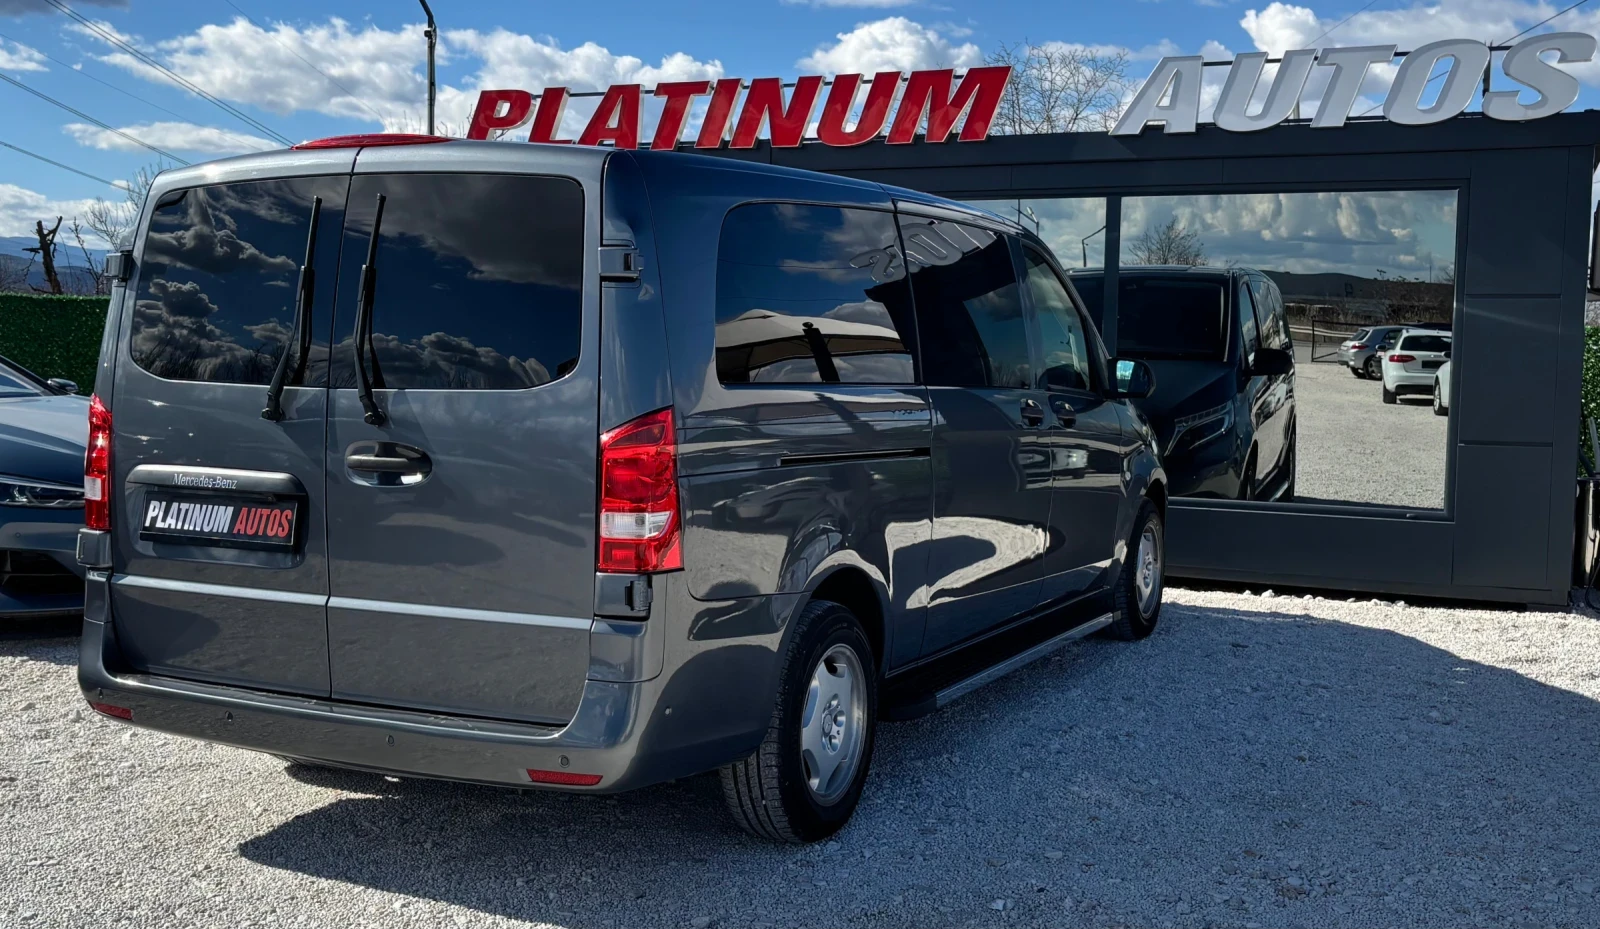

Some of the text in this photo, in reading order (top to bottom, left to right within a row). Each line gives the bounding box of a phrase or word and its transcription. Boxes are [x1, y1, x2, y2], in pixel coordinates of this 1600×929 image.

[466, 31, 1598, 151] PLATINUM AUTOS
[172, 473, 238, 490] Mercedes-Benz
[144, 500, 293, 538] PLATINUM AUTOS
